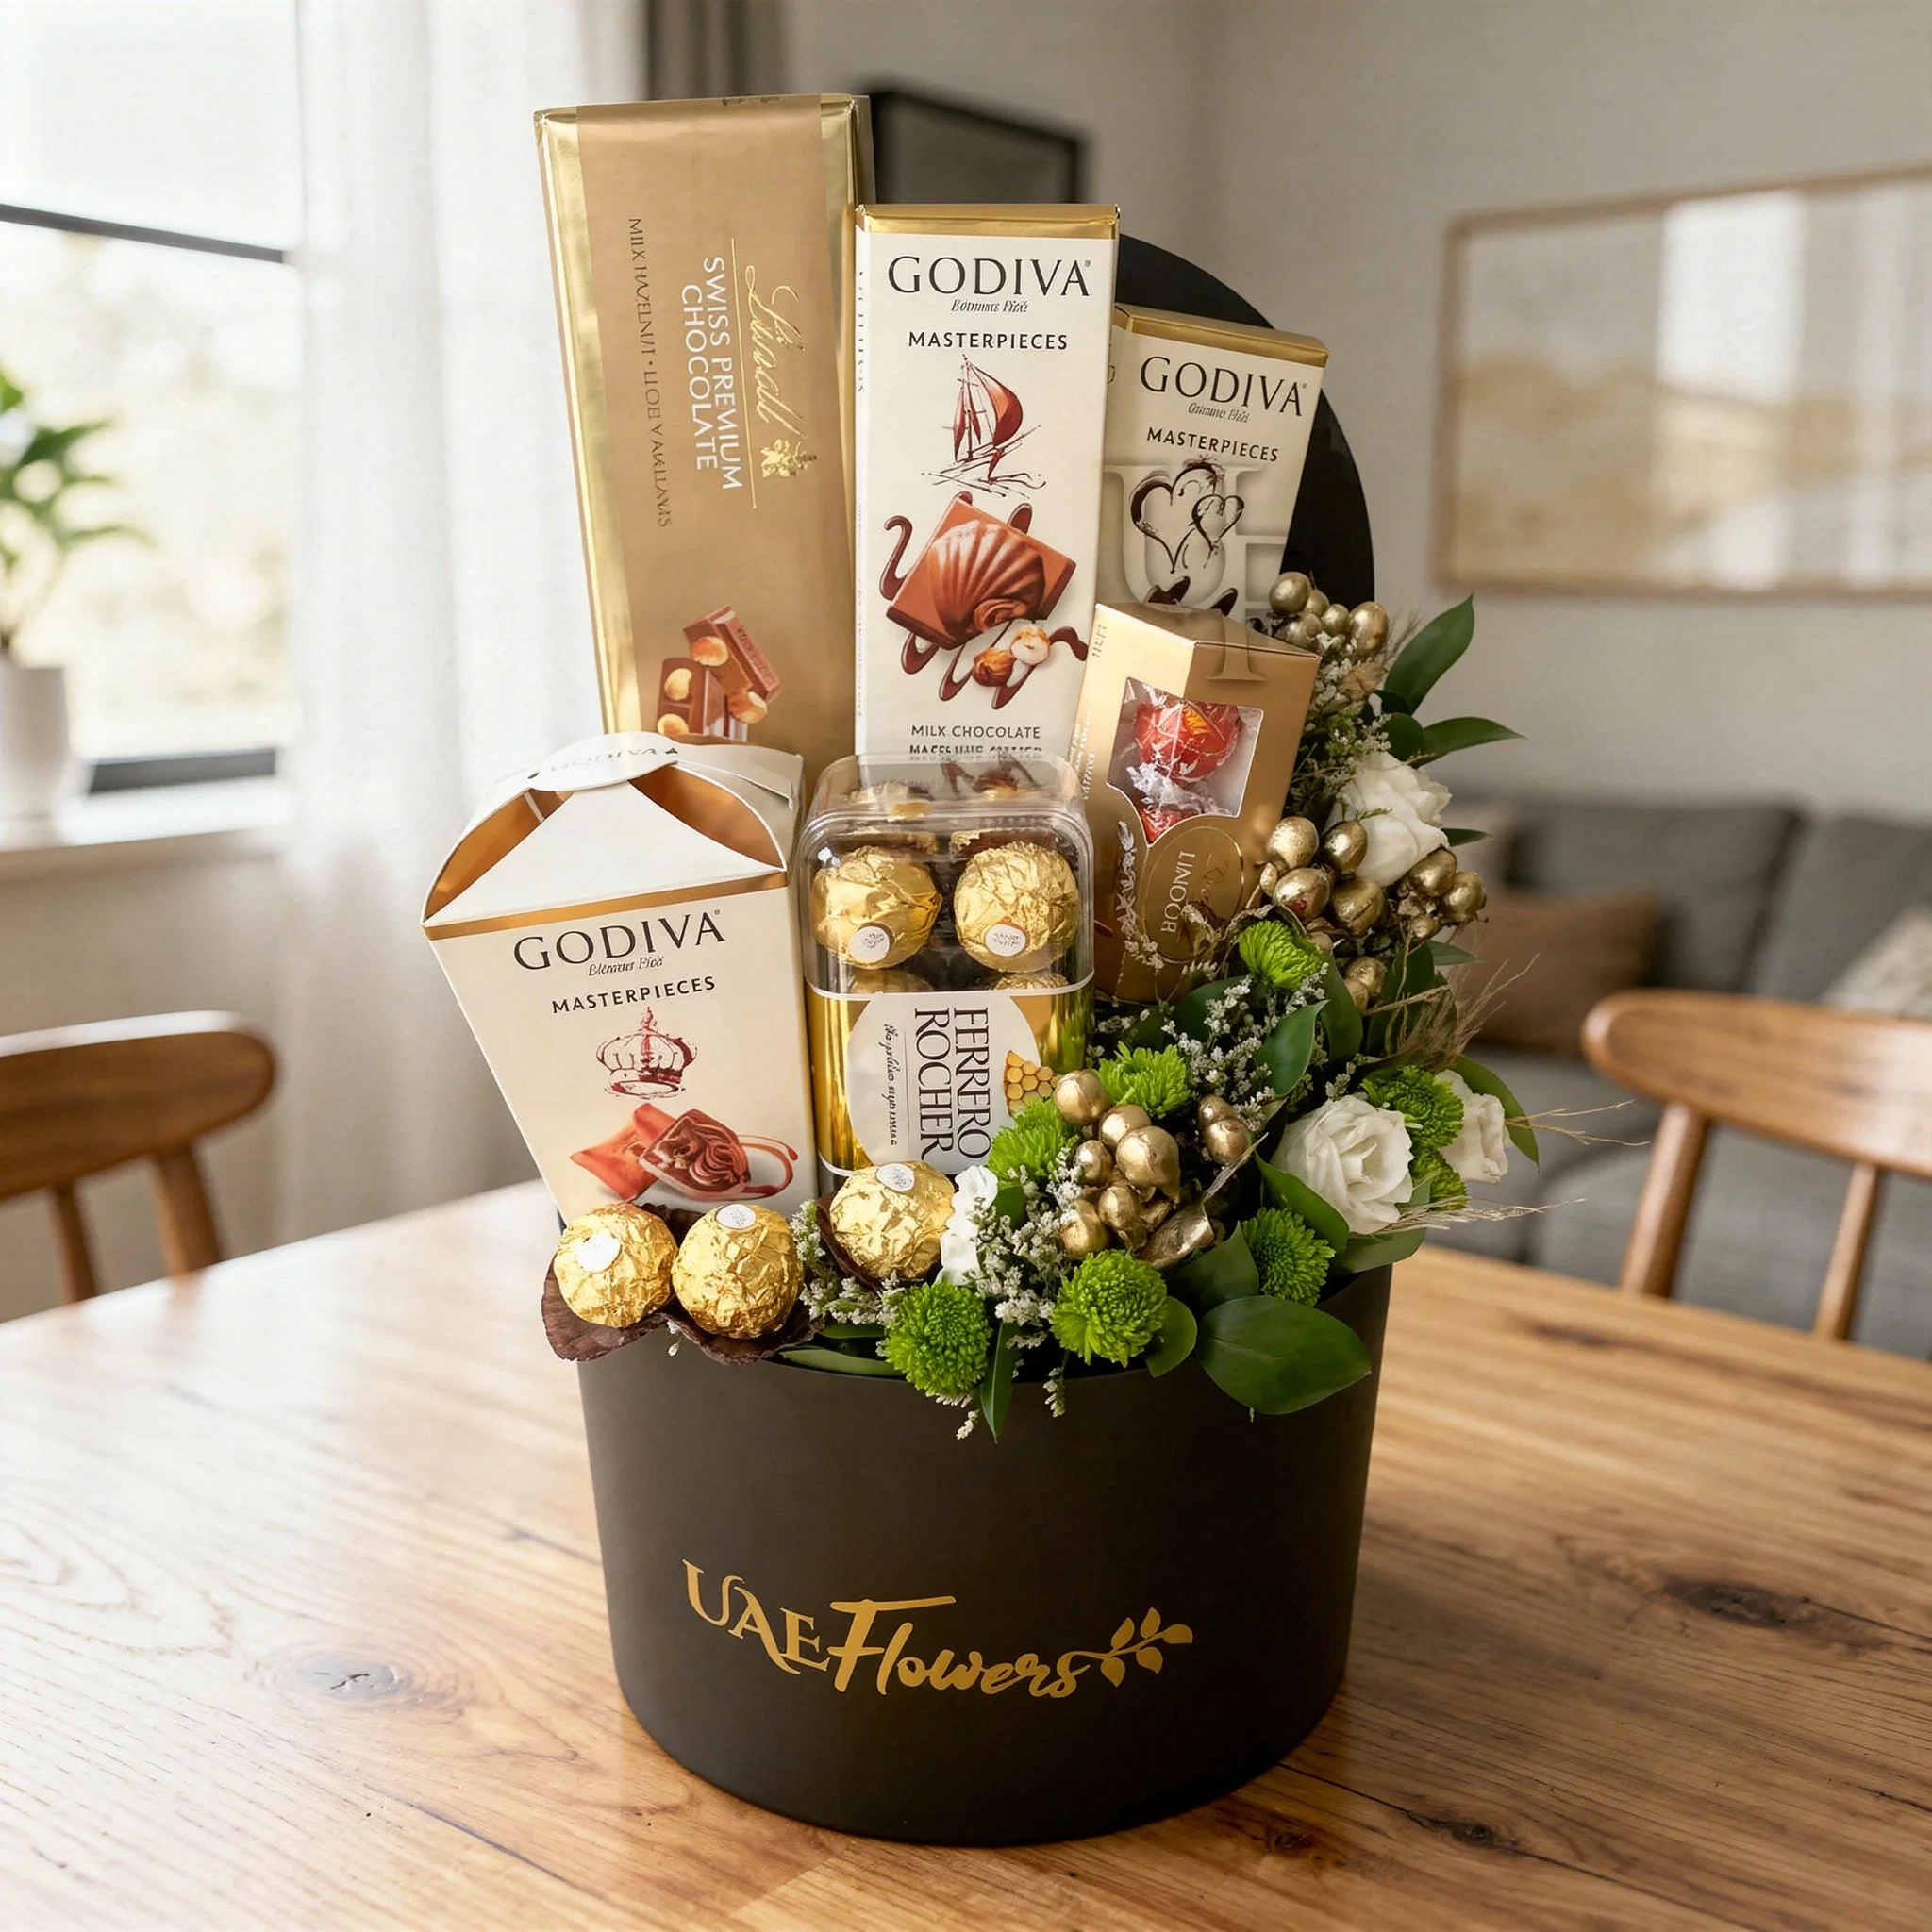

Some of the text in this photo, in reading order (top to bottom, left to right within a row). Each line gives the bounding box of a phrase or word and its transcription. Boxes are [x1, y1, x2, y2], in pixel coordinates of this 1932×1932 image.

[888, 256, 1091, 297] GODIVA
[908, 331, 1068, 351] MASTERPIECES
[680, 284, 717, 471] CHOCOLATE
[703, 256, 743, 490] SWISS PREMIUM
[1140, 356, 1303, 417] GODIVA
[1146, 426, 1280, 463] MASTERPIECES
[952, 725, 1041, 740] CHOCOLATE
[513, 910, 726, 971] GODIVA
[552, 975, 717, 1014] MASTERPIECES
[913, 1007, 955, 1162] ROCHER
[952, 1007, 992, 1161] FERRERO
[682, 1558, 1091, 1698] UAE Flowers
